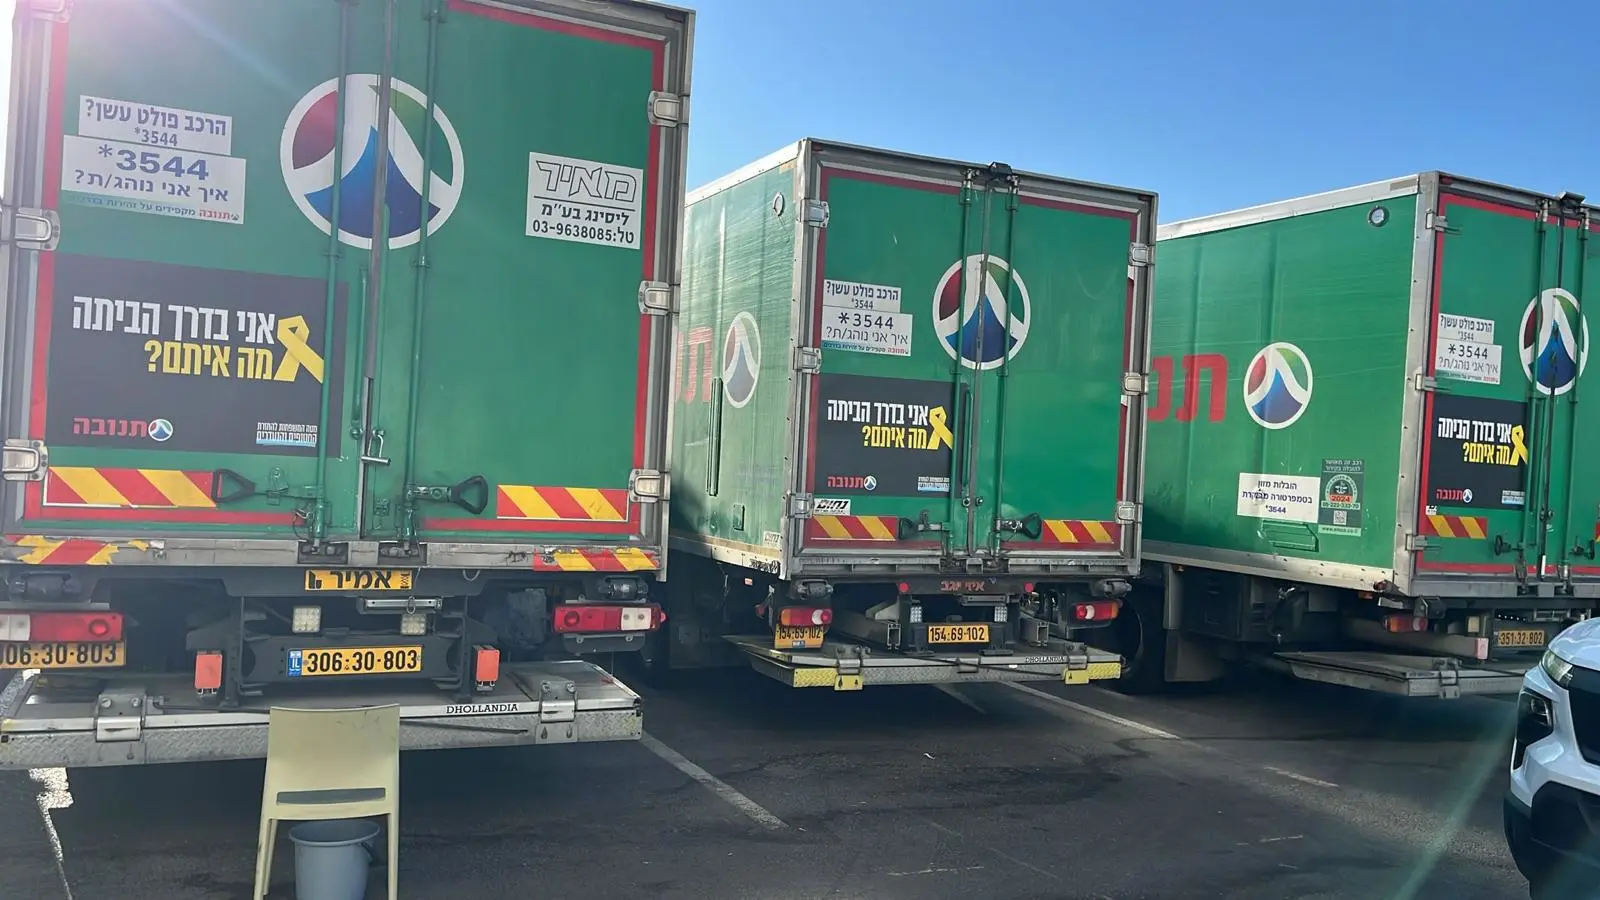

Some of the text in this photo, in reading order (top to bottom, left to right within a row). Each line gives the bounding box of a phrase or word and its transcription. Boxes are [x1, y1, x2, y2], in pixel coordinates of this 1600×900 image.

[85, 98, 226, 136] הרכב פולט עשן?
[162, 181, 191, 197] אני
[536, 160, 637, 203] מאיר
[198, 188, 229, 203] איך
[156, 205, 195, 216] מקפידים
[585, 209, 630, 226] ליסינג
[826, 281, 899, 300] הרכב פולט עשן?
[72, 295, 276, 345] אני בדרך הביתה
[872, 331, 888, 343] אני
[891, 333, 908, 346] איך
[144, 339, 274, 380] מה איתם?
[827, 399, 928, 426] אני בדרך הביתה
[72, 417, 148, 438] תנובה
[862, 425, 927, 449] מה איתם?
[1438, 417, 1512, 443] אני בדרך הביתה
[1463, 442, 1510, 465] מה איתם?
[827, 476, 864, 489] תנובה
[1273, 480, 1297, 490] הובלות
[1436, 489, 1463, 500] תנובה
[330, 570, 392, 589] אמיר
[0, 643, 117, 665] 06-30-803
[446, 704, 518, 714] DHOLLANDIA
